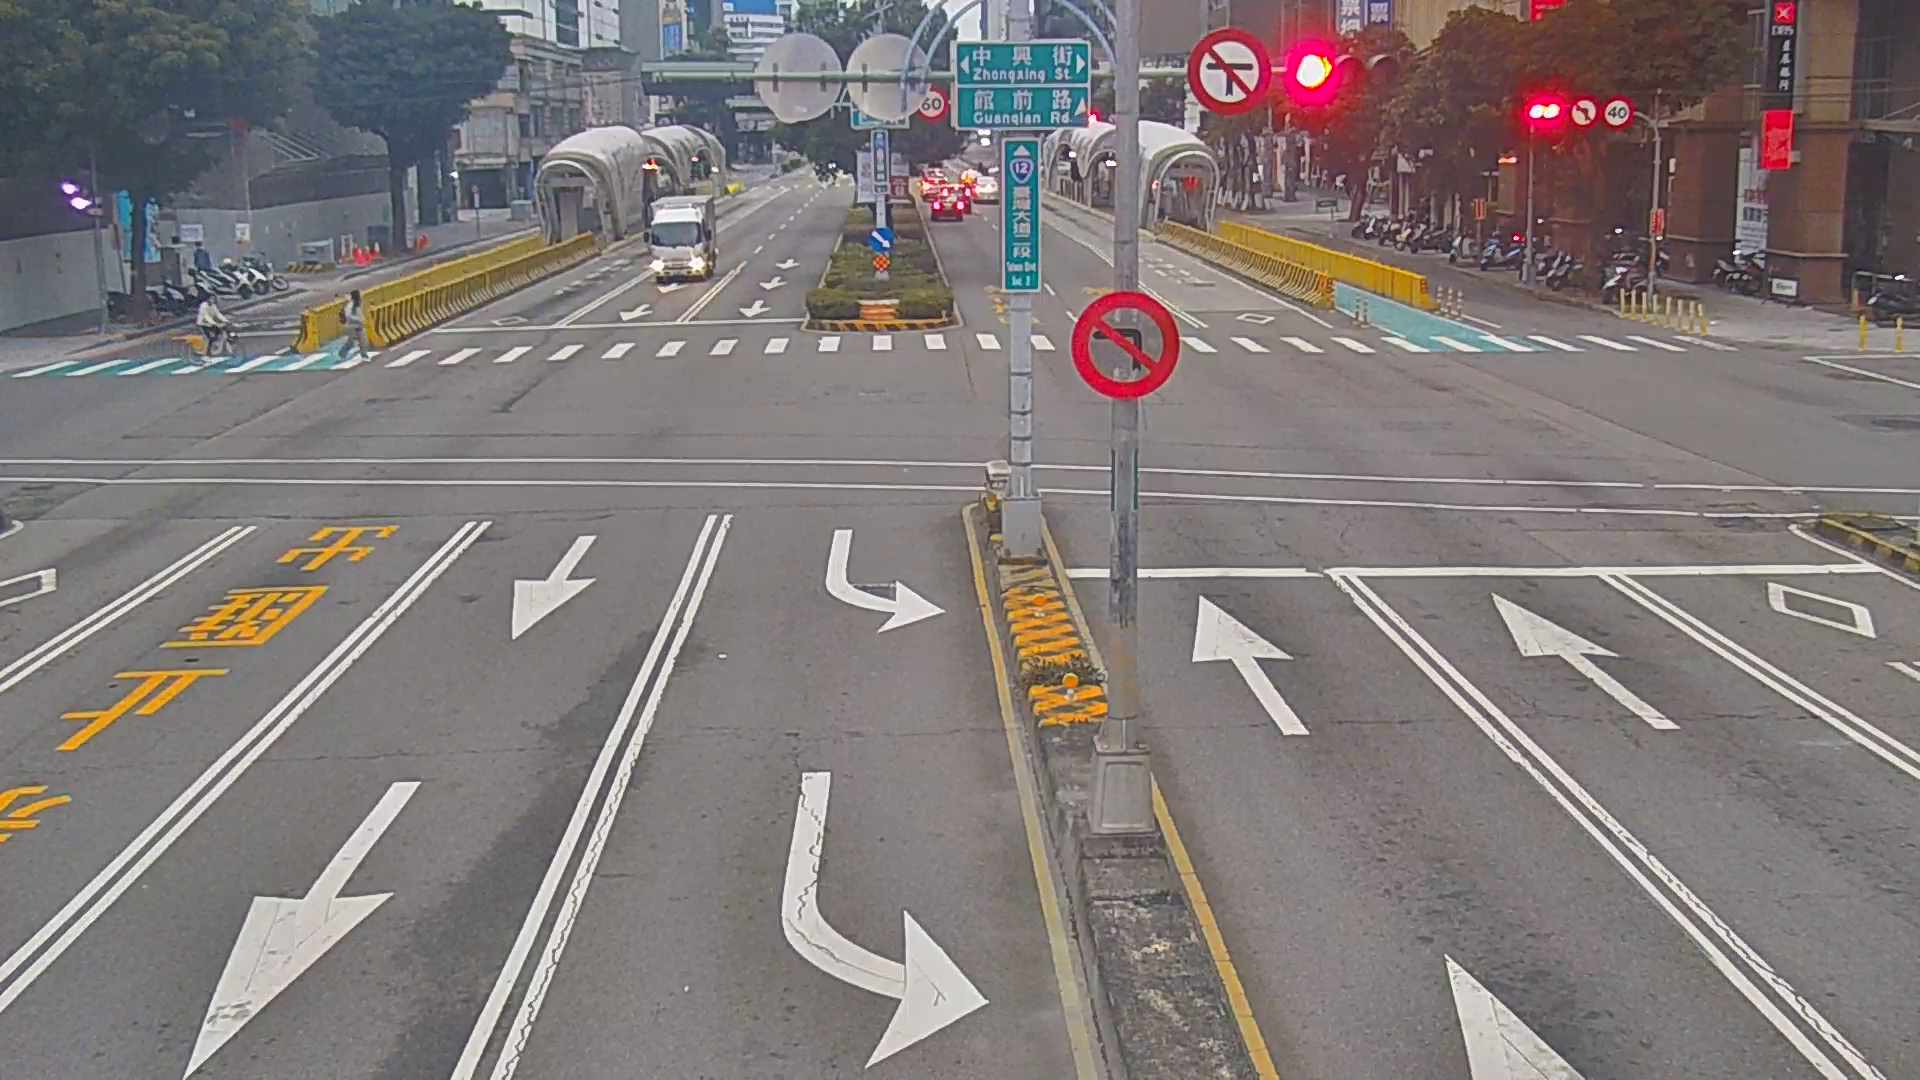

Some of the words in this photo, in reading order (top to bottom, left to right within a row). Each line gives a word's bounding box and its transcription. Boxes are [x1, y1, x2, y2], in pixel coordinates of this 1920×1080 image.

[972, 45, 1073, 66] 中興街
[973, 67, 1046, 83] Zhongxing
[921, 96, 942, 112] 60
[974, 89, 1072, 111] 館前路
[973, 111, 1041, 126] Guanqian
[1607, 106, 1628, 119] 40
[1015, 163, 1028, 174] 12
